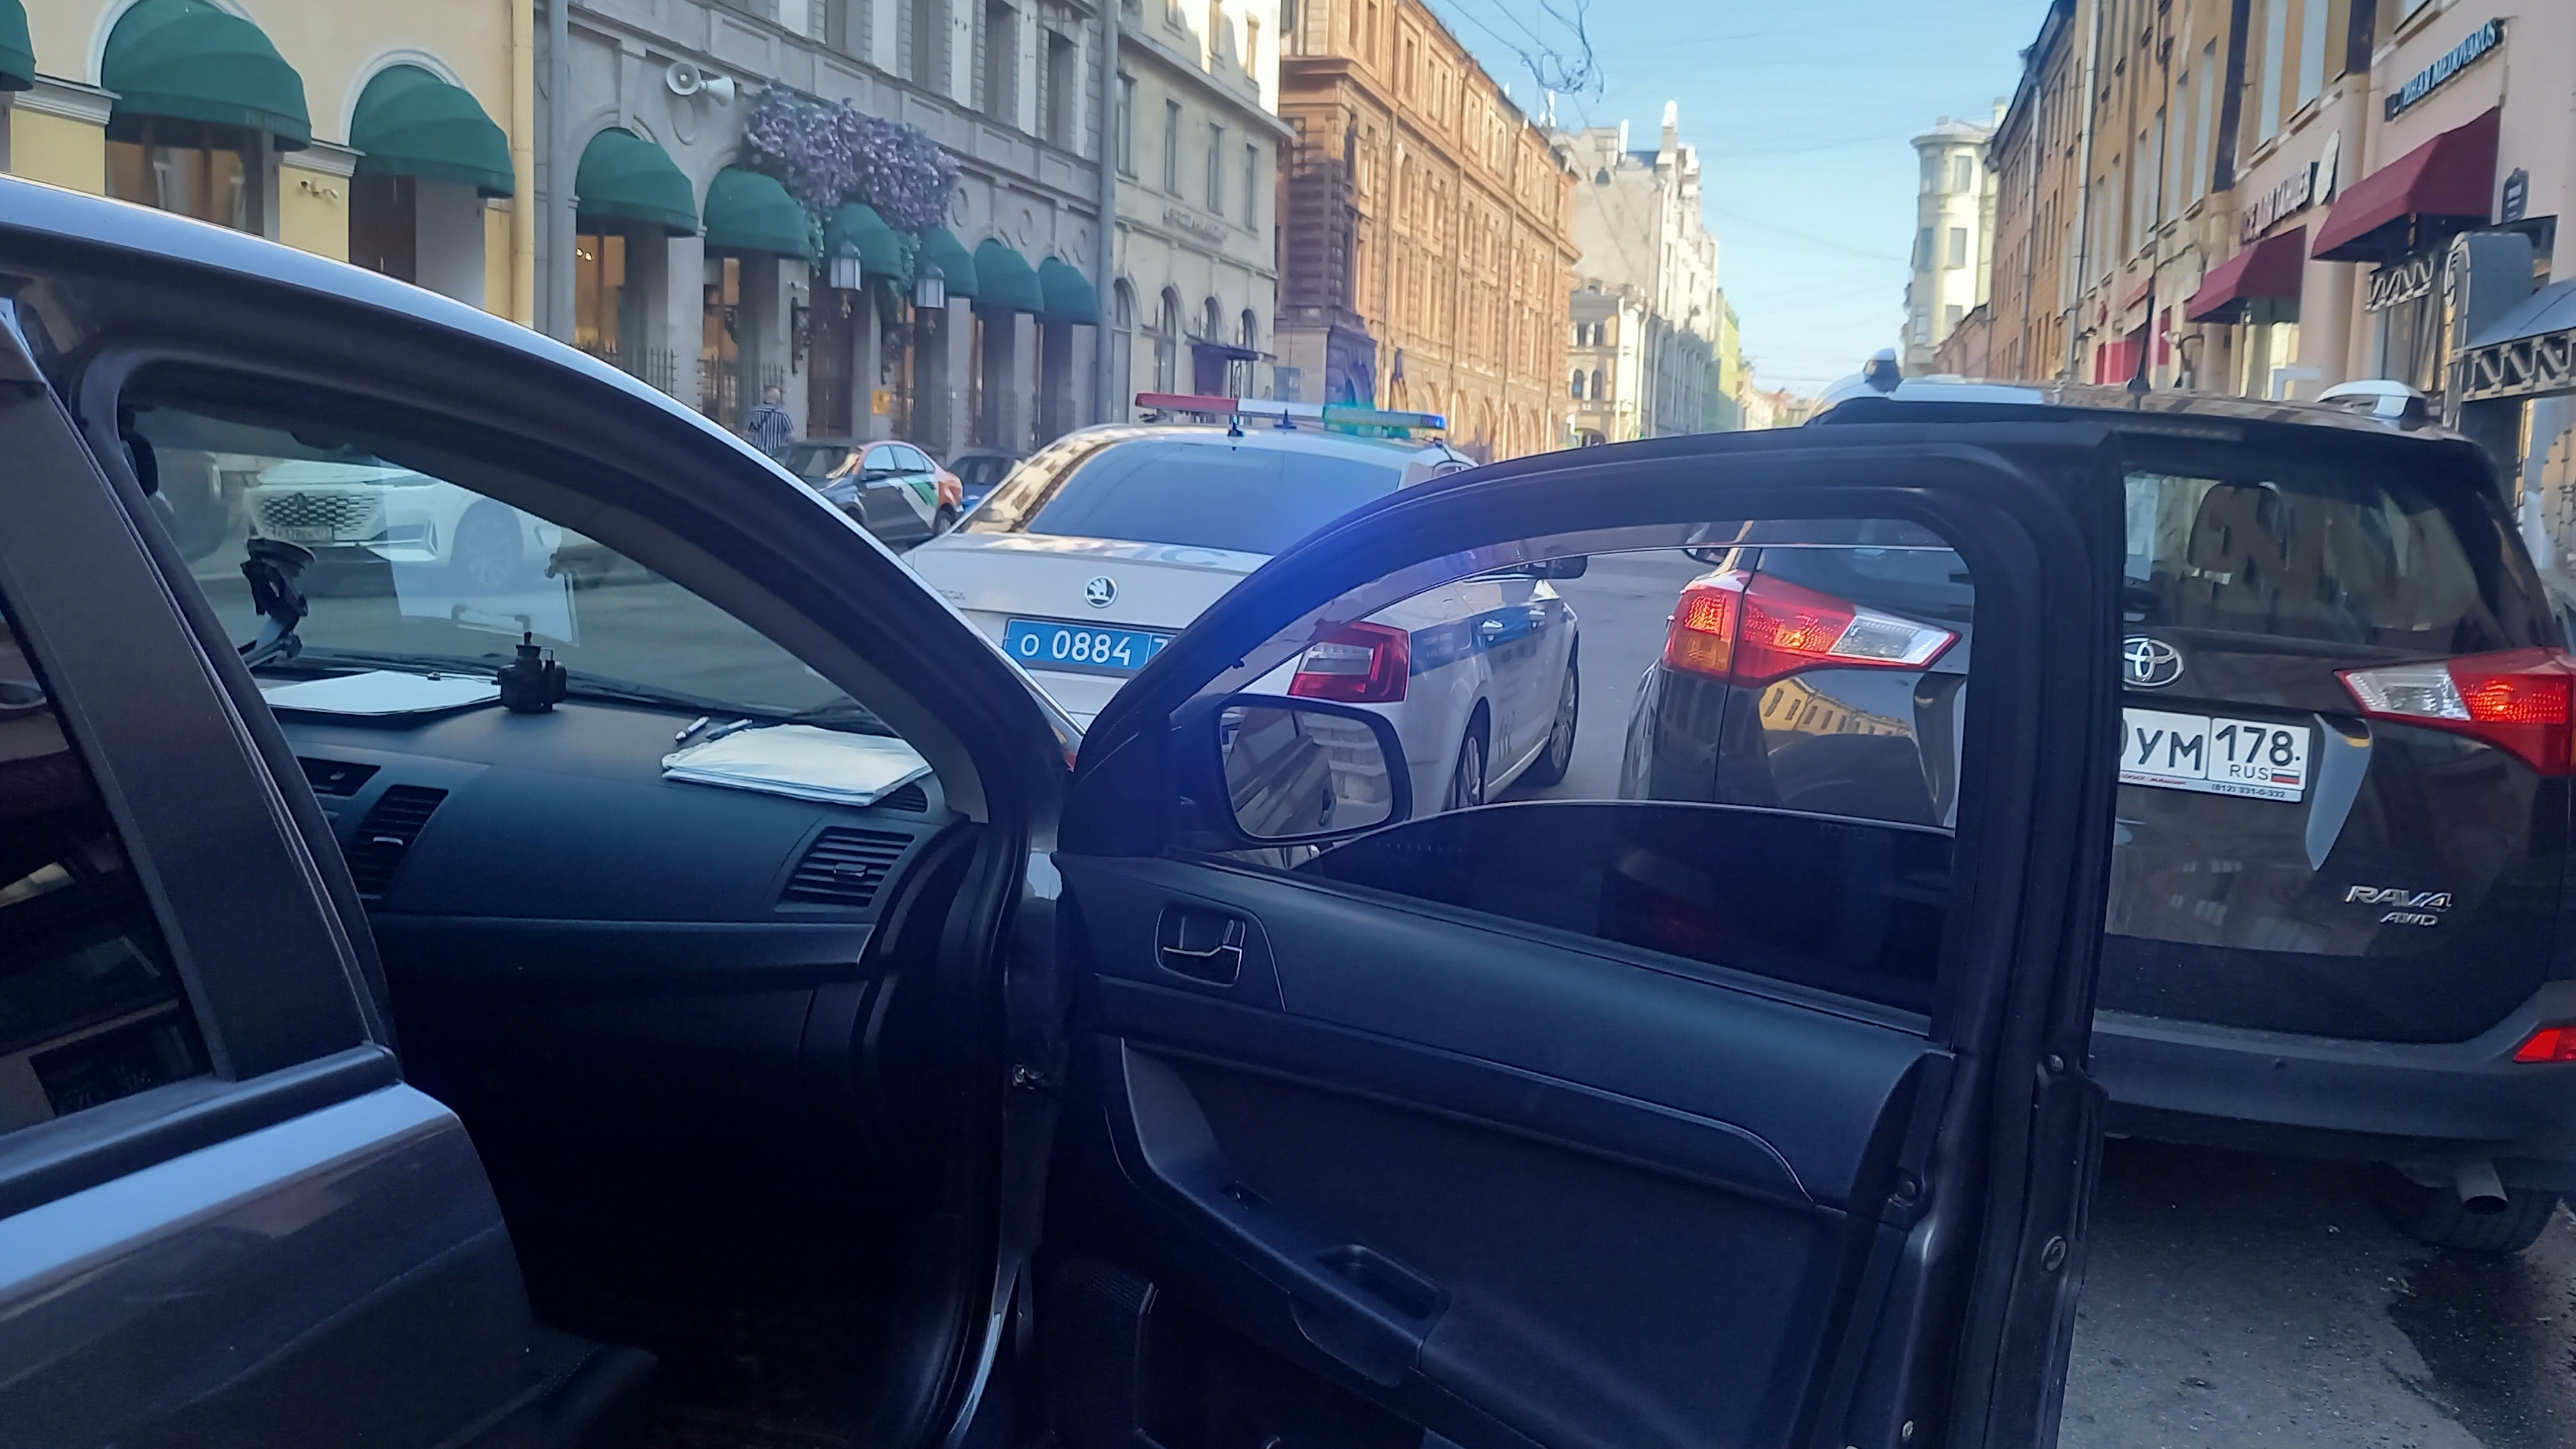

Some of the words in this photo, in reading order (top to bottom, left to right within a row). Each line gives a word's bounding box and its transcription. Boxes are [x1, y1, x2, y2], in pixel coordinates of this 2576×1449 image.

[1053, 630, 1131, 666] 0884
[2215, 724, 2293, 767] 178
[2229, 764, 2270, 781] RUS
[2345, 885, 2452, 912] RAV4
[2379, 912, 2439, 926] AWD
